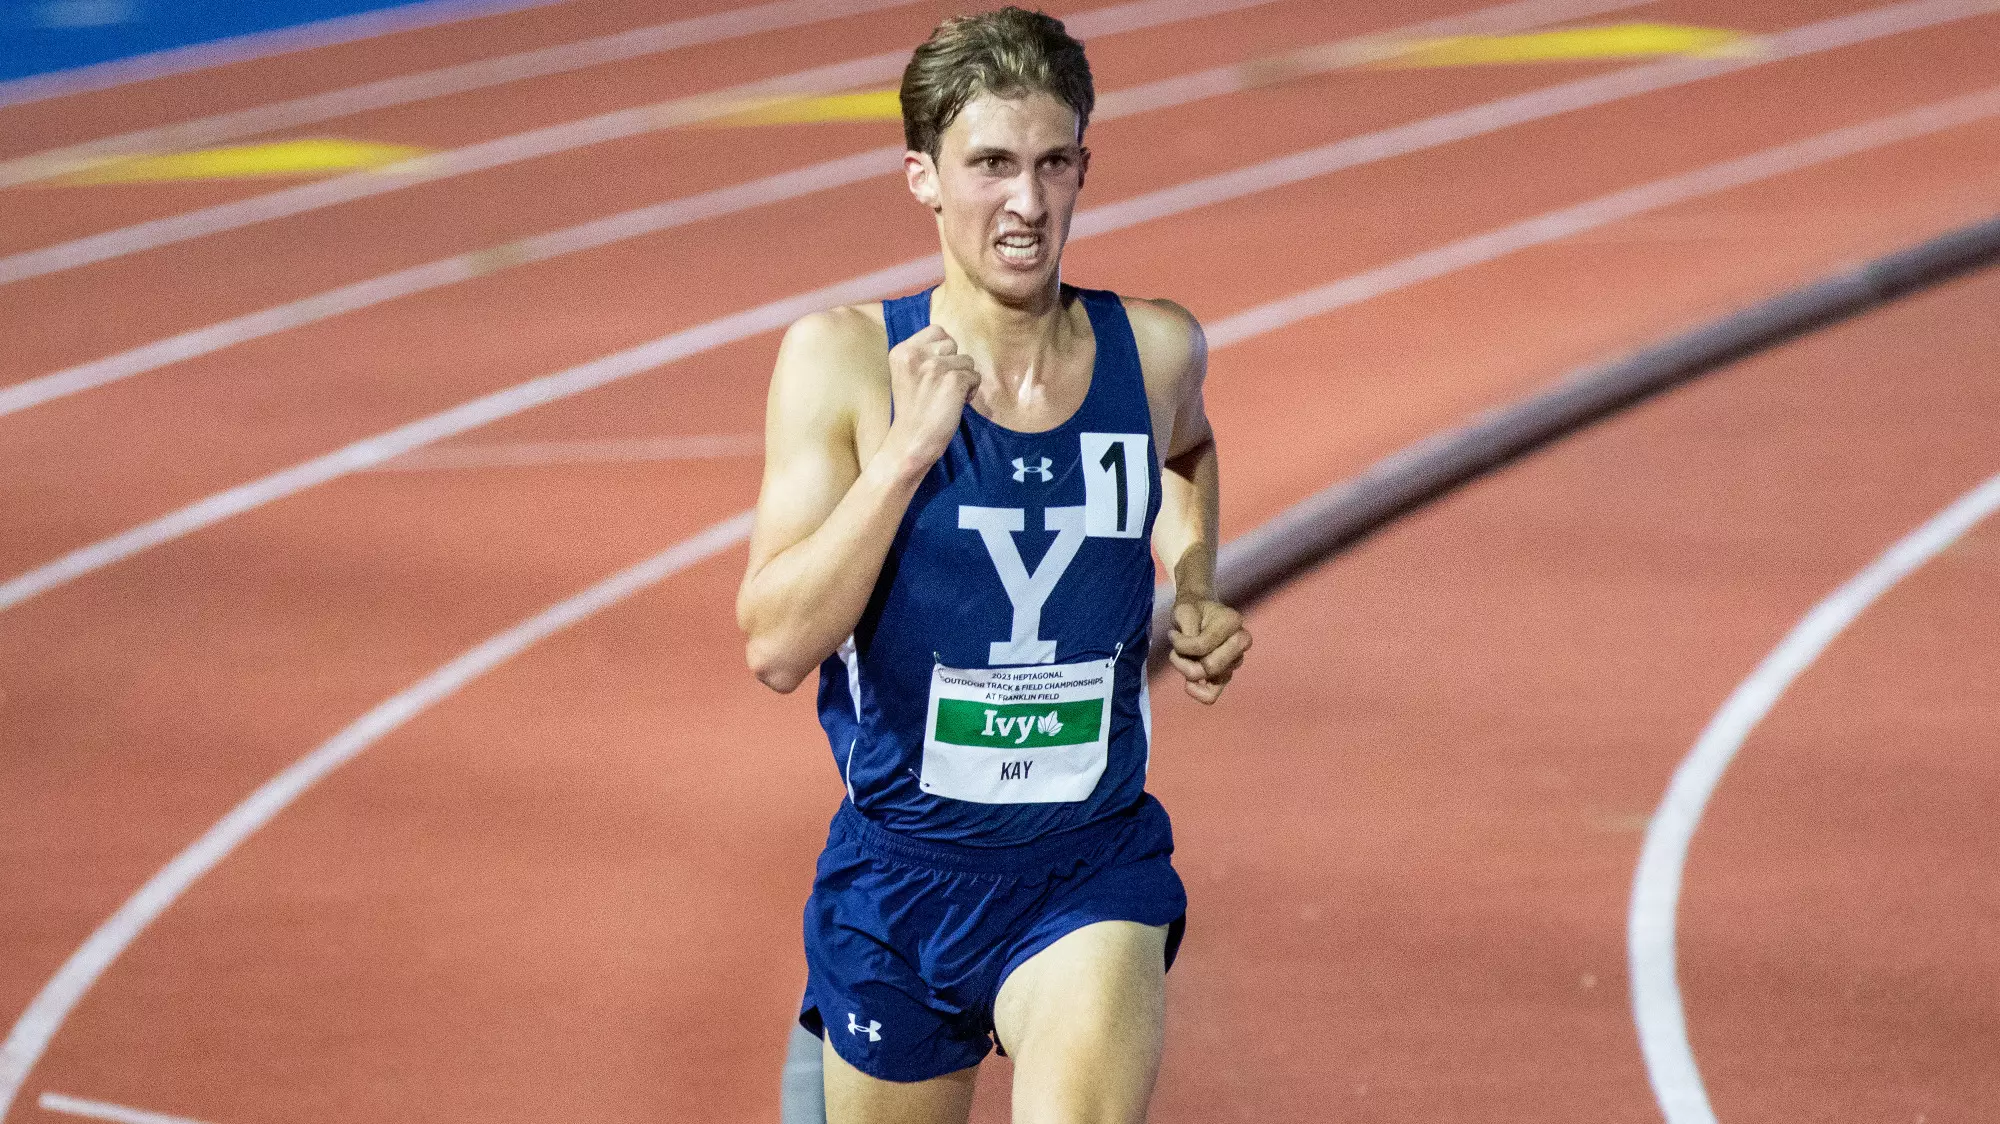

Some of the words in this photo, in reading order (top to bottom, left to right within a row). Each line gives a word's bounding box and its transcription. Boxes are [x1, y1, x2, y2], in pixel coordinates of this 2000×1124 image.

[1100, 441, 1129, 532] 1
[958, 505, 1087, 665] Y
[944, 677, 985, 689] OUTDOOR
[987, 681, 1013, 692] TRACK
[1022, 683, 1043, 691] FIELD
[1044, 677, 1104, 690] CHAMPIONSHIPS
[992, 672, 1011, 681] 2023
[1013, 671, 1063, 681] HEPTAGONAL
[986, 692, 996, 700] AT
[998, 693, 1036, 701] FRANKLIN
[981, 709, 1036, 744] Ivy
[1000, 760, 1033, 780] KAY
